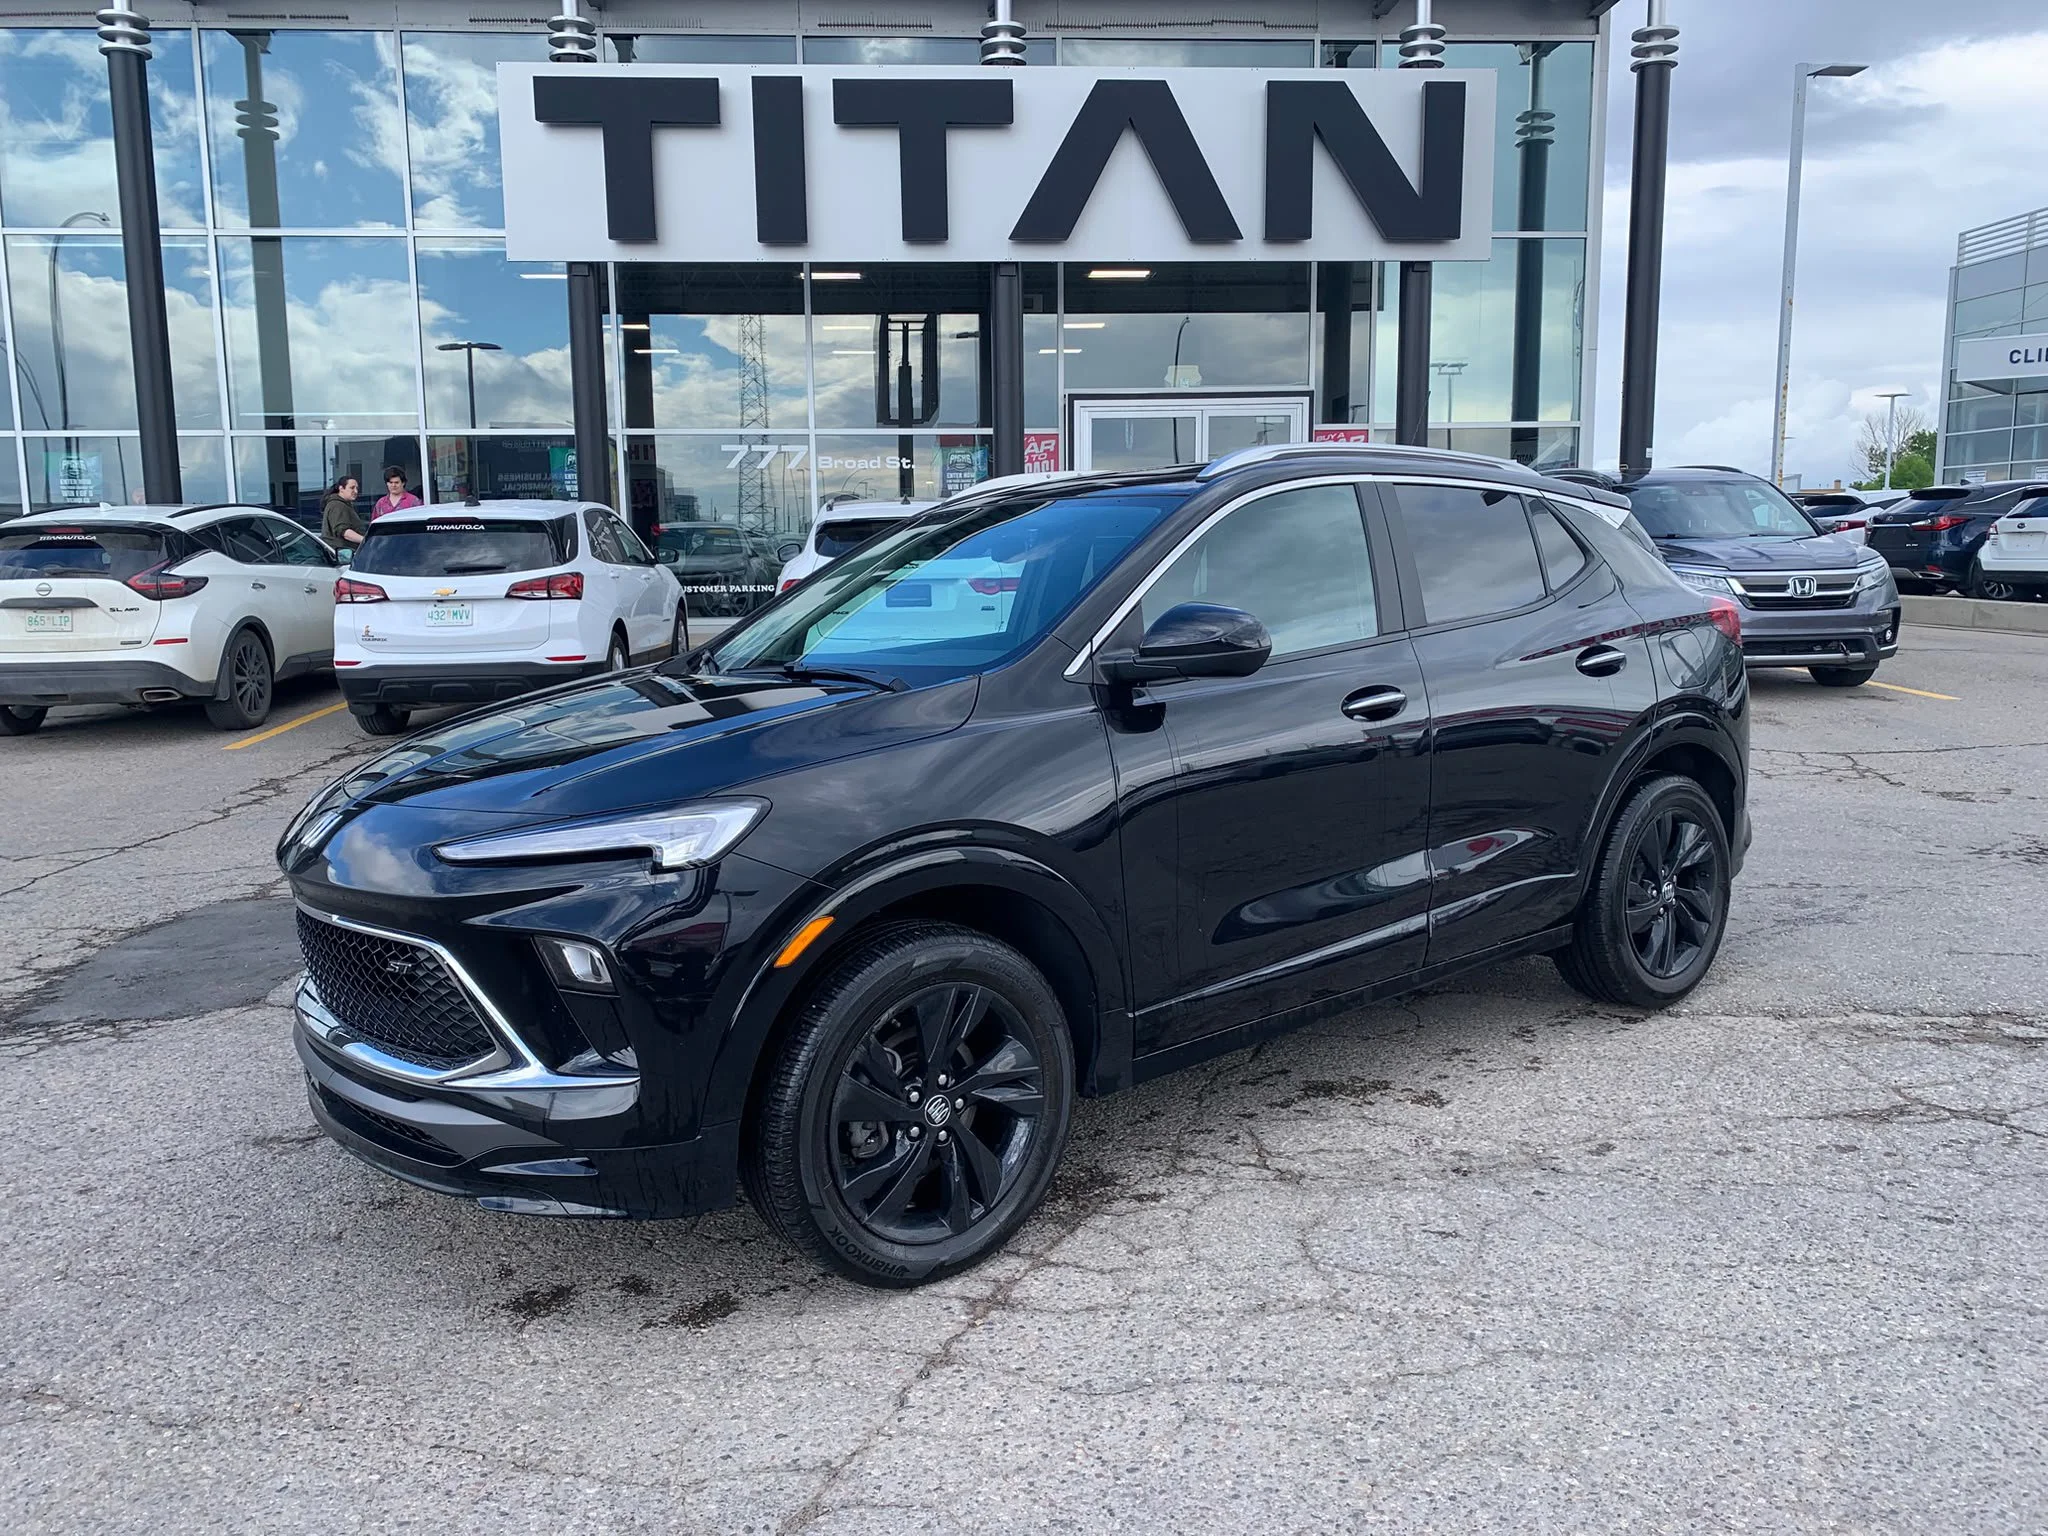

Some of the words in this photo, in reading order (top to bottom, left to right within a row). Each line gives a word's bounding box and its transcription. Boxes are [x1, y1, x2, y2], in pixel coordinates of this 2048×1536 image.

[532, 75, 1466, 244] TITAN
[1316, 433, 1337, 442] BUY
[1024, 439, 1056, 455] AR
[720, 444, 809, 470] 777
[817, 456, 882, 470] Broad
[885, 455, 916, 470] St.
[682, 585, 728, 593] USTOMER
[729, 584, 775, 593] PARKING
[27, 615, 46, 626] 865
[52, 615, 70, 627] LIP
[428, 610, 446, 621] 432
[452, 609, 470, 620] MVV
